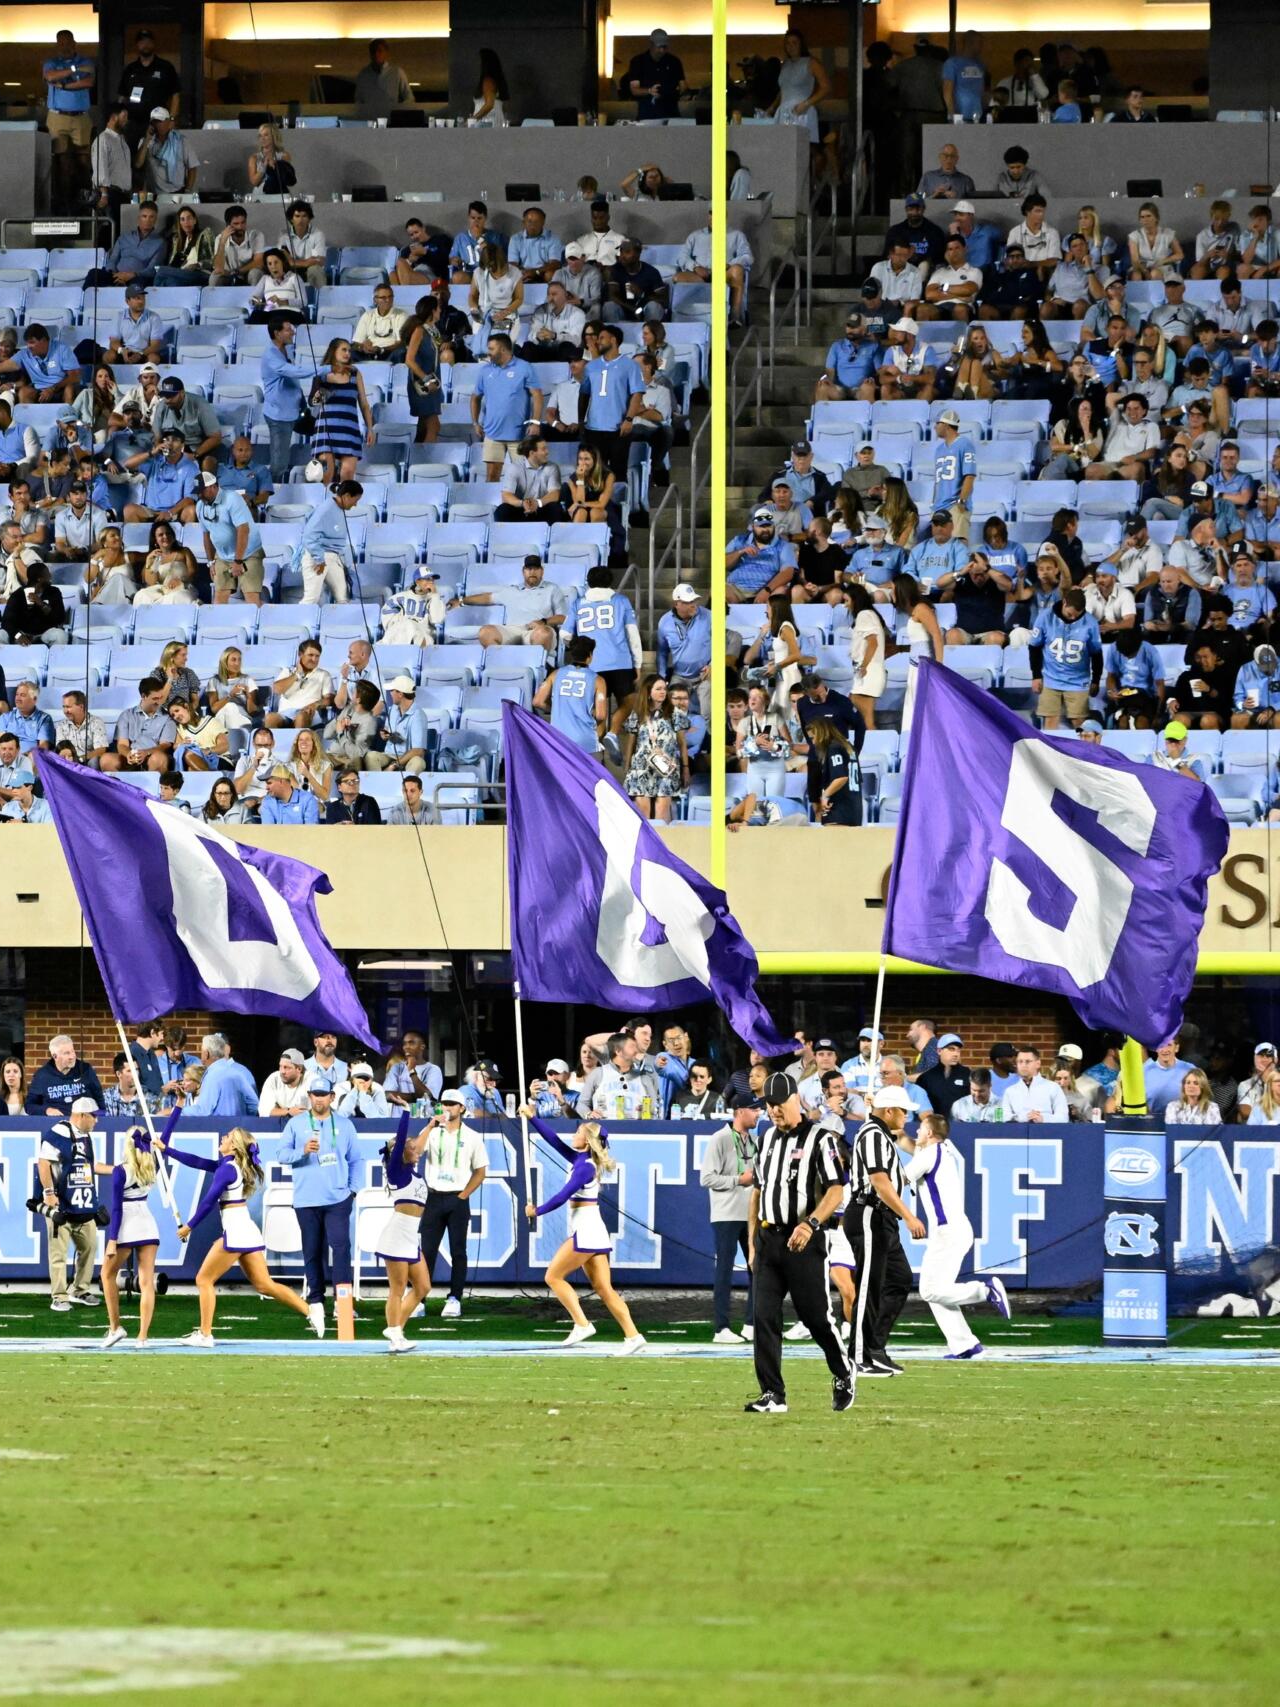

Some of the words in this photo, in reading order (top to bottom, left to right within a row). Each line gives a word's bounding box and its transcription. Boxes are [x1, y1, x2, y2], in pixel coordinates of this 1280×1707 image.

[599, 369, 608, 397] 1
[577, 604, 615, 633] 28
[1048, 637, 1084, 664] 49
[559, 680, 586, 698] 23
[831, 754, 843, 766] 10
[983, 738, 1157, 989] S
[47, 1083, 86, 1094] CAROLINA
[48, 1090, 63, 1100] TAR
[1116, 1156, 1152, 1171] ACC
[71, 1187, 94, 1209] 42
[1104, 1306, 1158, 1320] REATNESS
